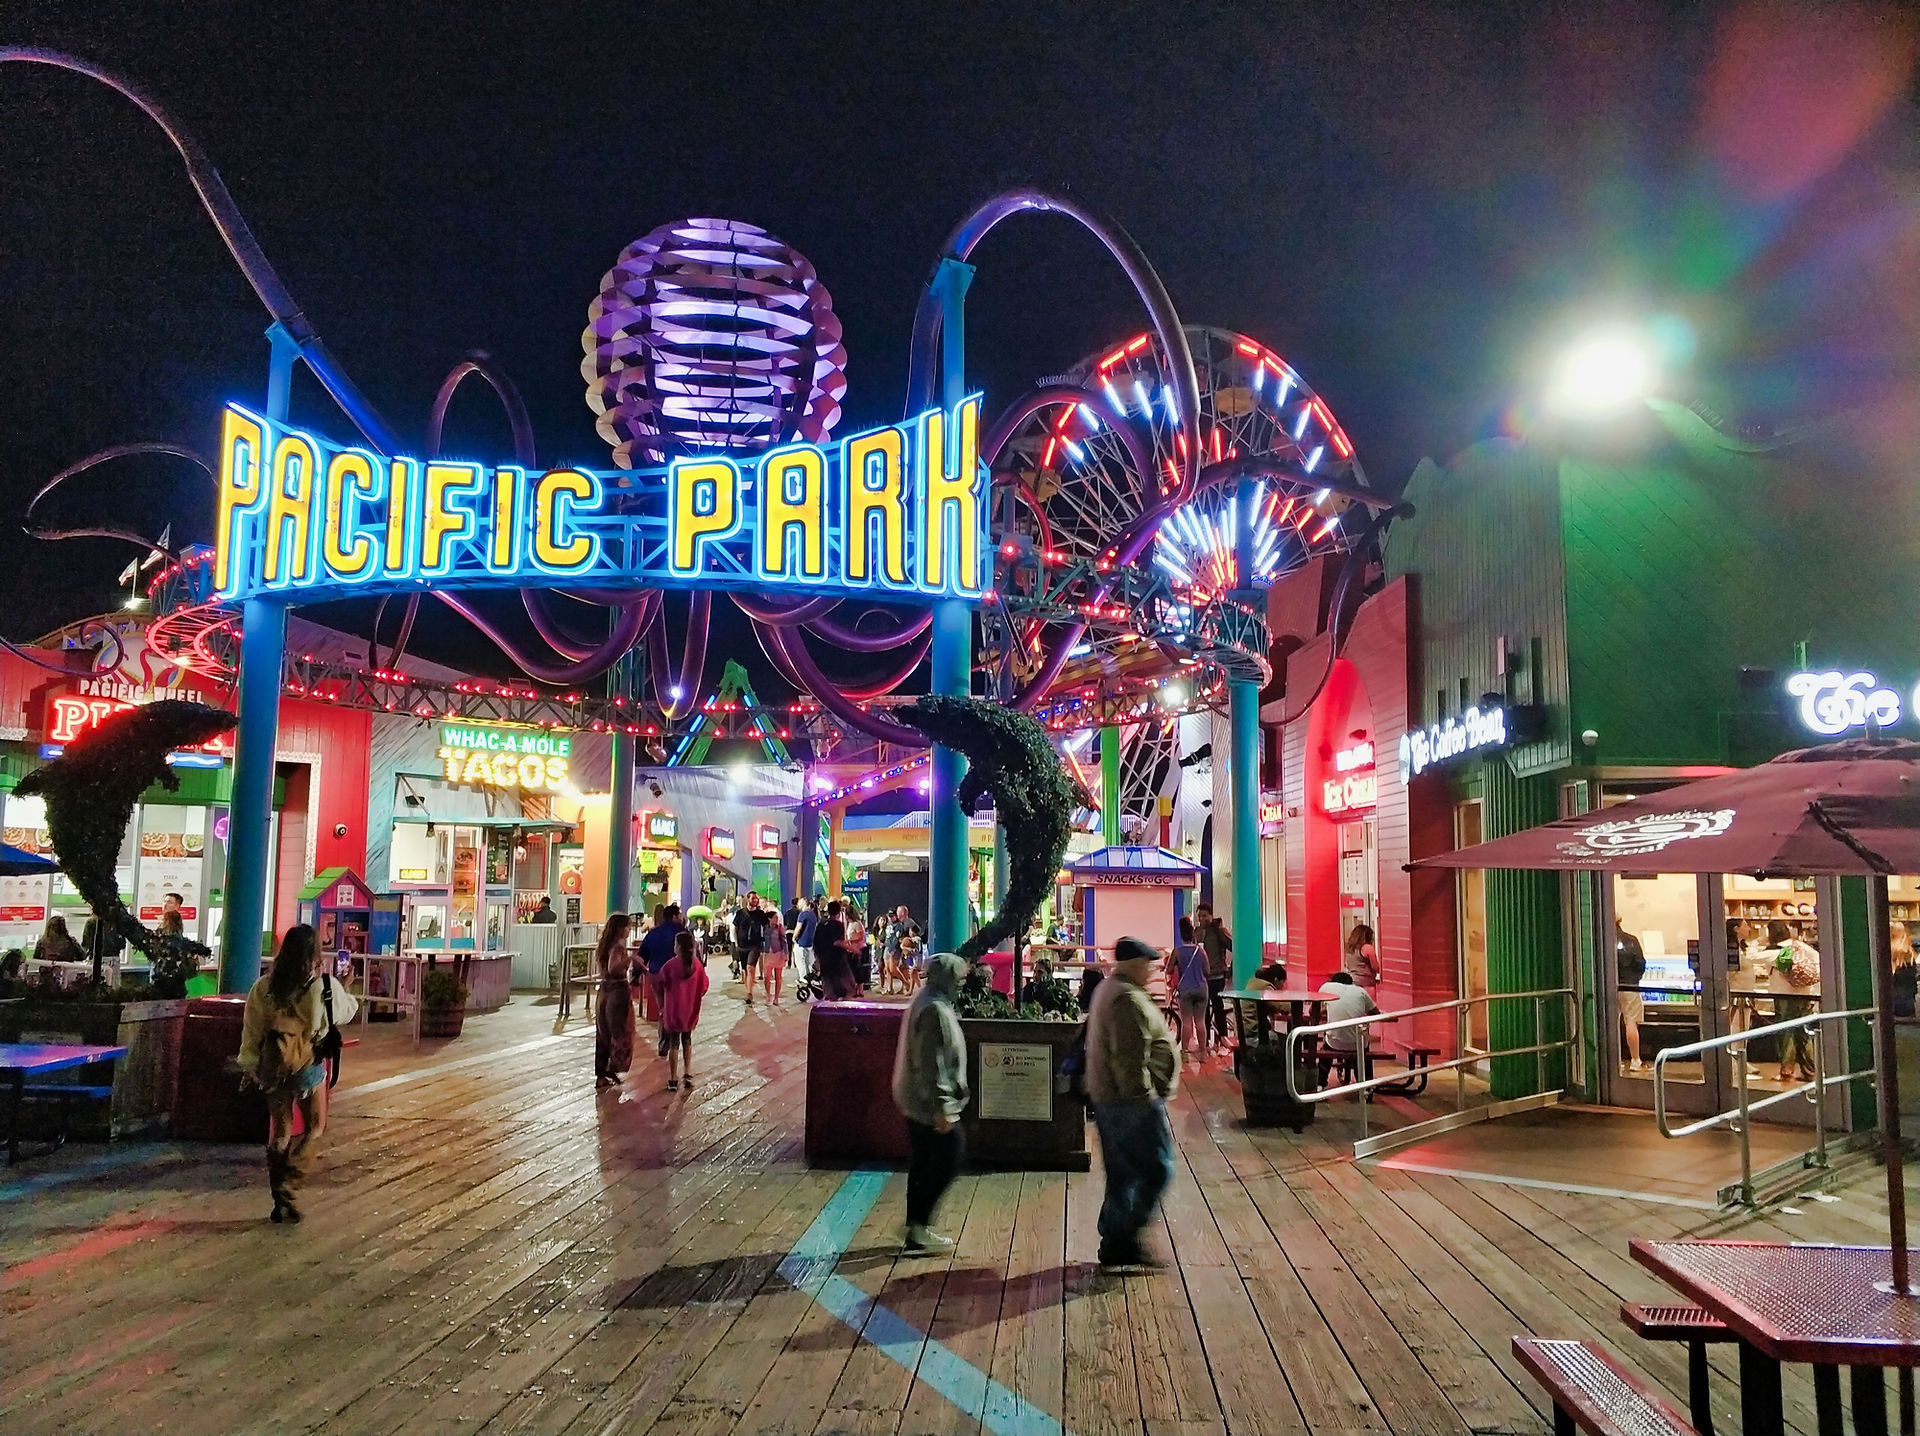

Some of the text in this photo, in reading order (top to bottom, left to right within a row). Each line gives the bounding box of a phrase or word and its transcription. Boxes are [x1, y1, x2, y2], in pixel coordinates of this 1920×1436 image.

[213, 391, 985, 600] PACIFIC PARK
[80, 680, 204, 704] PACIFIC WHEEL
[1788, 671, 1900, 735] The
[444, 728, 570, 758] WHAC-A-MOLE
[1411, 730, 1430, 775] The
[1430, 716, 1466, 763] Coffee
[1466, 706, 1506, 749] Bean
[438, 745, 570, 790] TACOS
[1324, 782, 1343, 810] ICE
[1096, 874, 1144, 885] SNACKS
